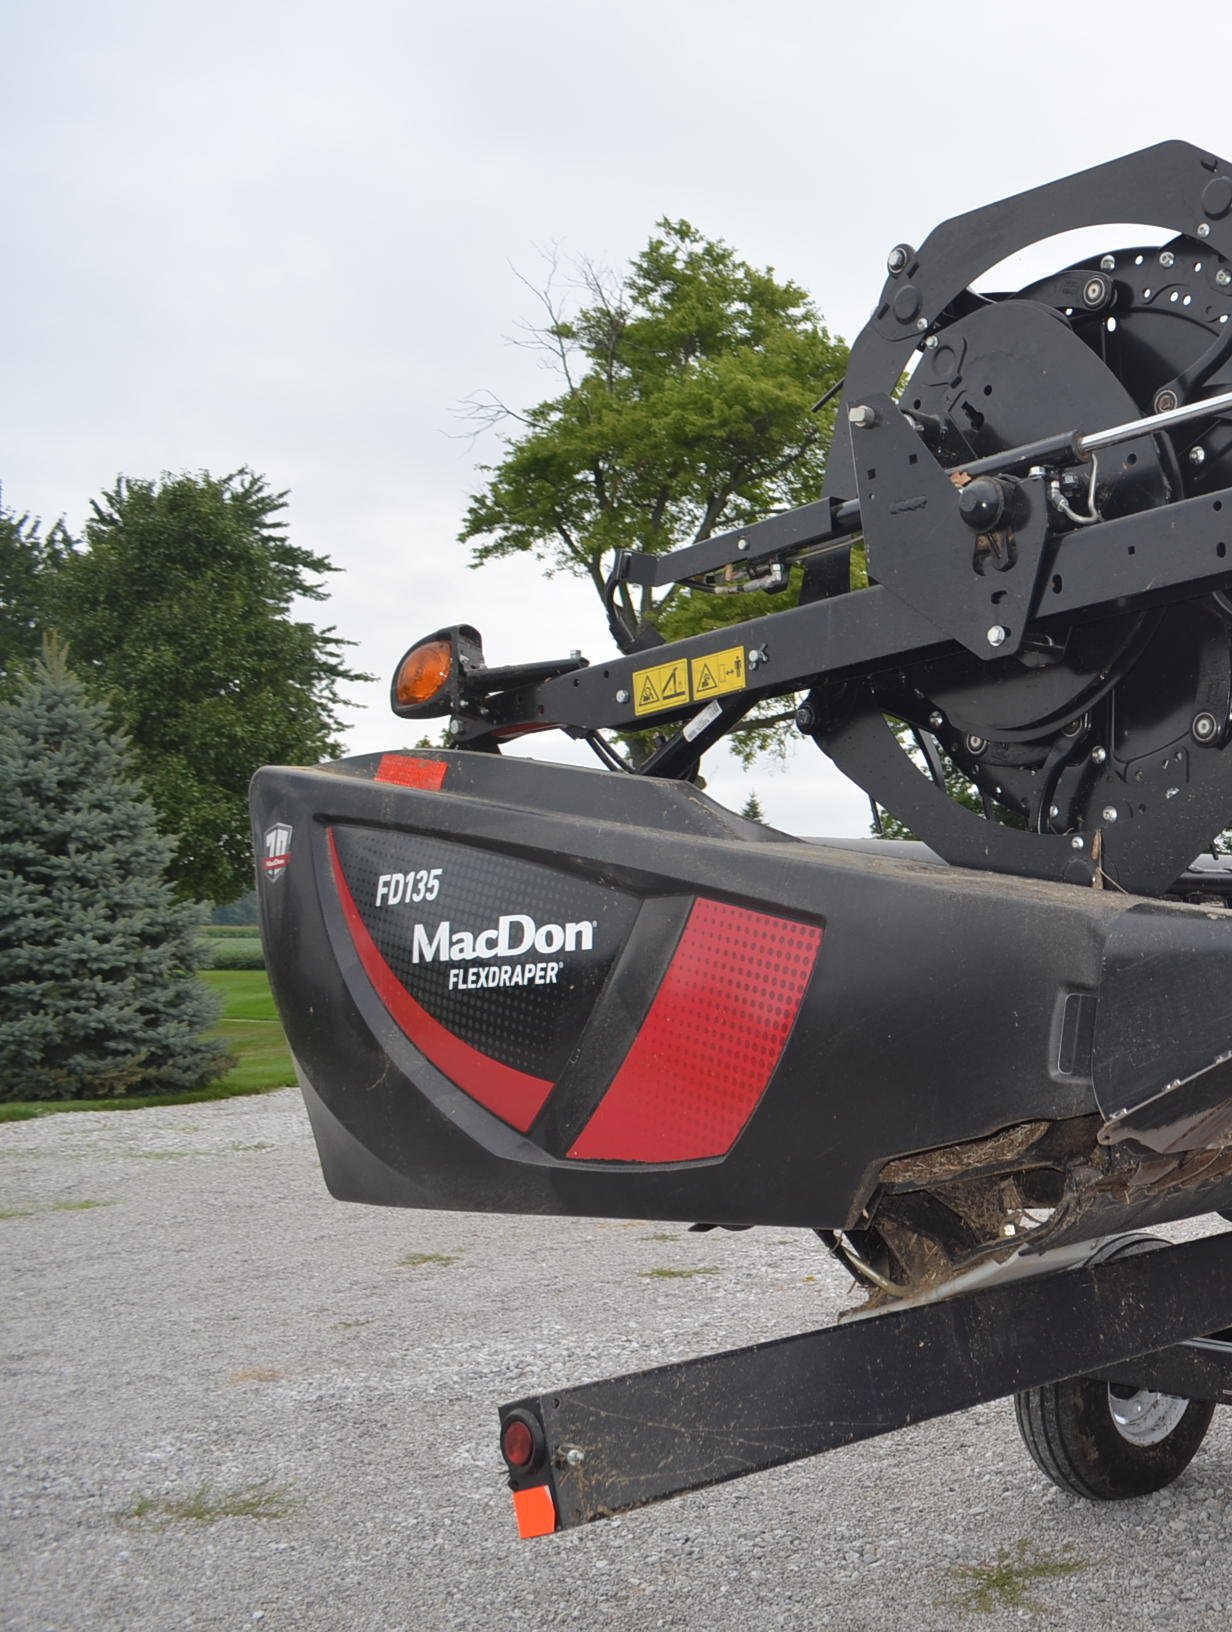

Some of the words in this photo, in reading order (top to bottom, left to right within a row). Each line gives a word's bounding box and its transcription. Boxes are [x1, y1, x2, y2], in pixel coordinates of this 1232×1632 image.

[375, 868, 443, 907] FD135
[412, 914, 594, 964] MacDon
[449, 962, 558, 990] FLEXDRAPER
